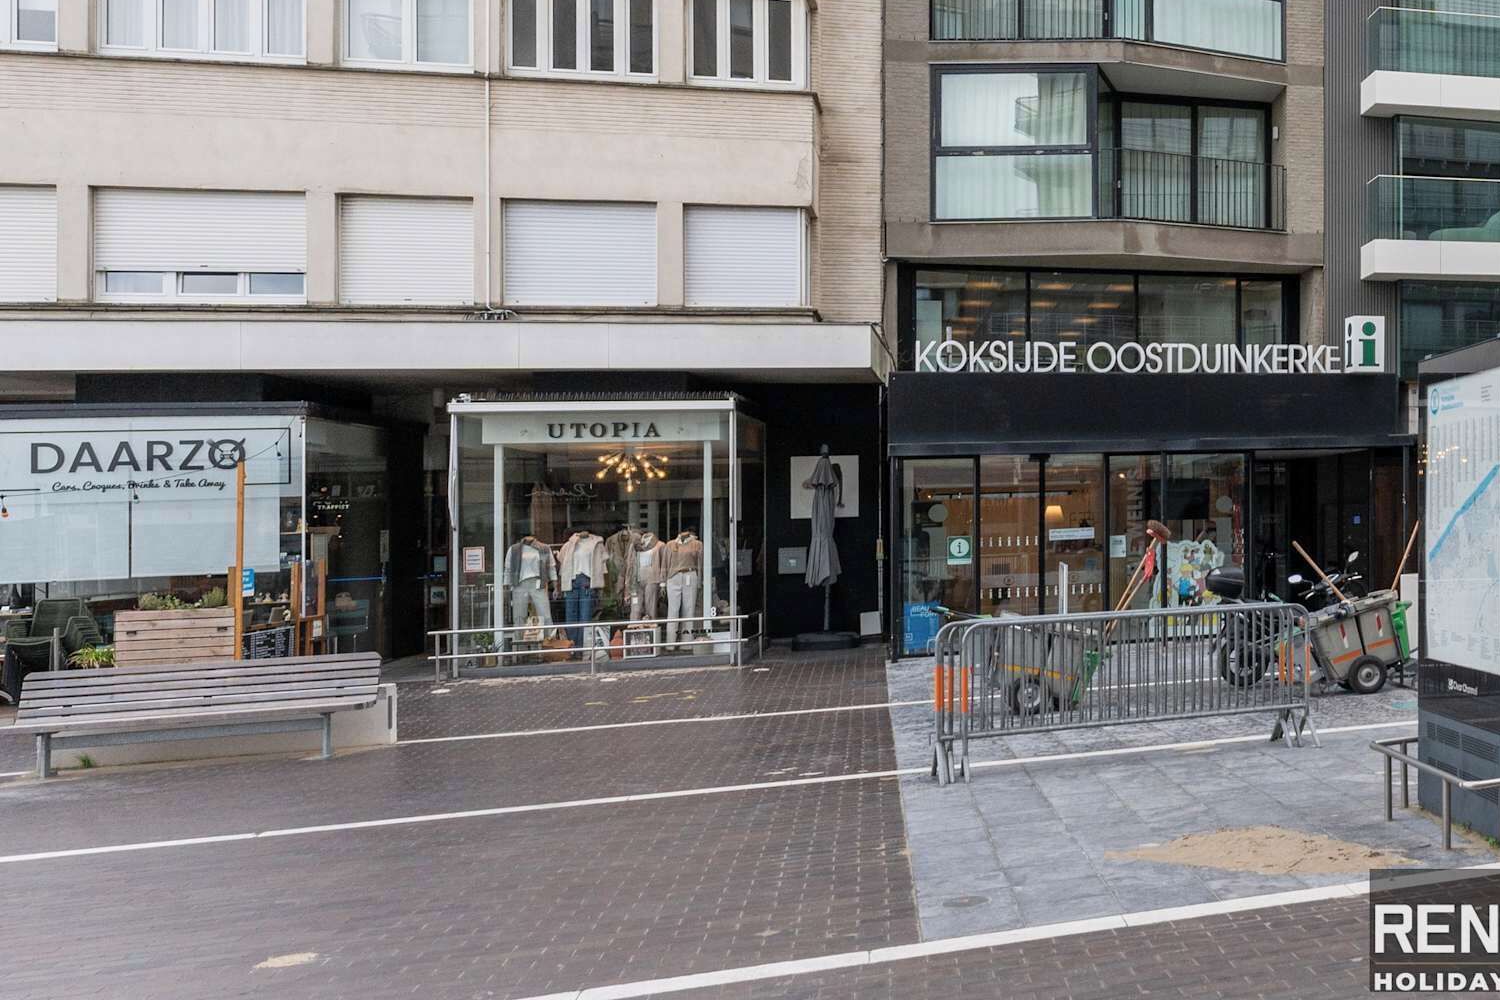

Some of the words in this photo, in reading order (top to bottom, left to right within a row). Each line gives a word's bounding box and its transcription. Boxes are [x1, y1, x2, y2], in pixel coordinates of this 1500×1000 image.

[914, 340, 1077, 373] KOKSIJDE
[1086, 341, 1341, 374] OOSTDUINKERKE
[547, 422, 662, 438] UTOPIA
[30, 438, 246, 474] DAARZO
[163, 479, 171, 488] &
[174, 478, 196, 488] Take
[198, 478, 226, 491] Away
[710, 606, 717, 617] 8
